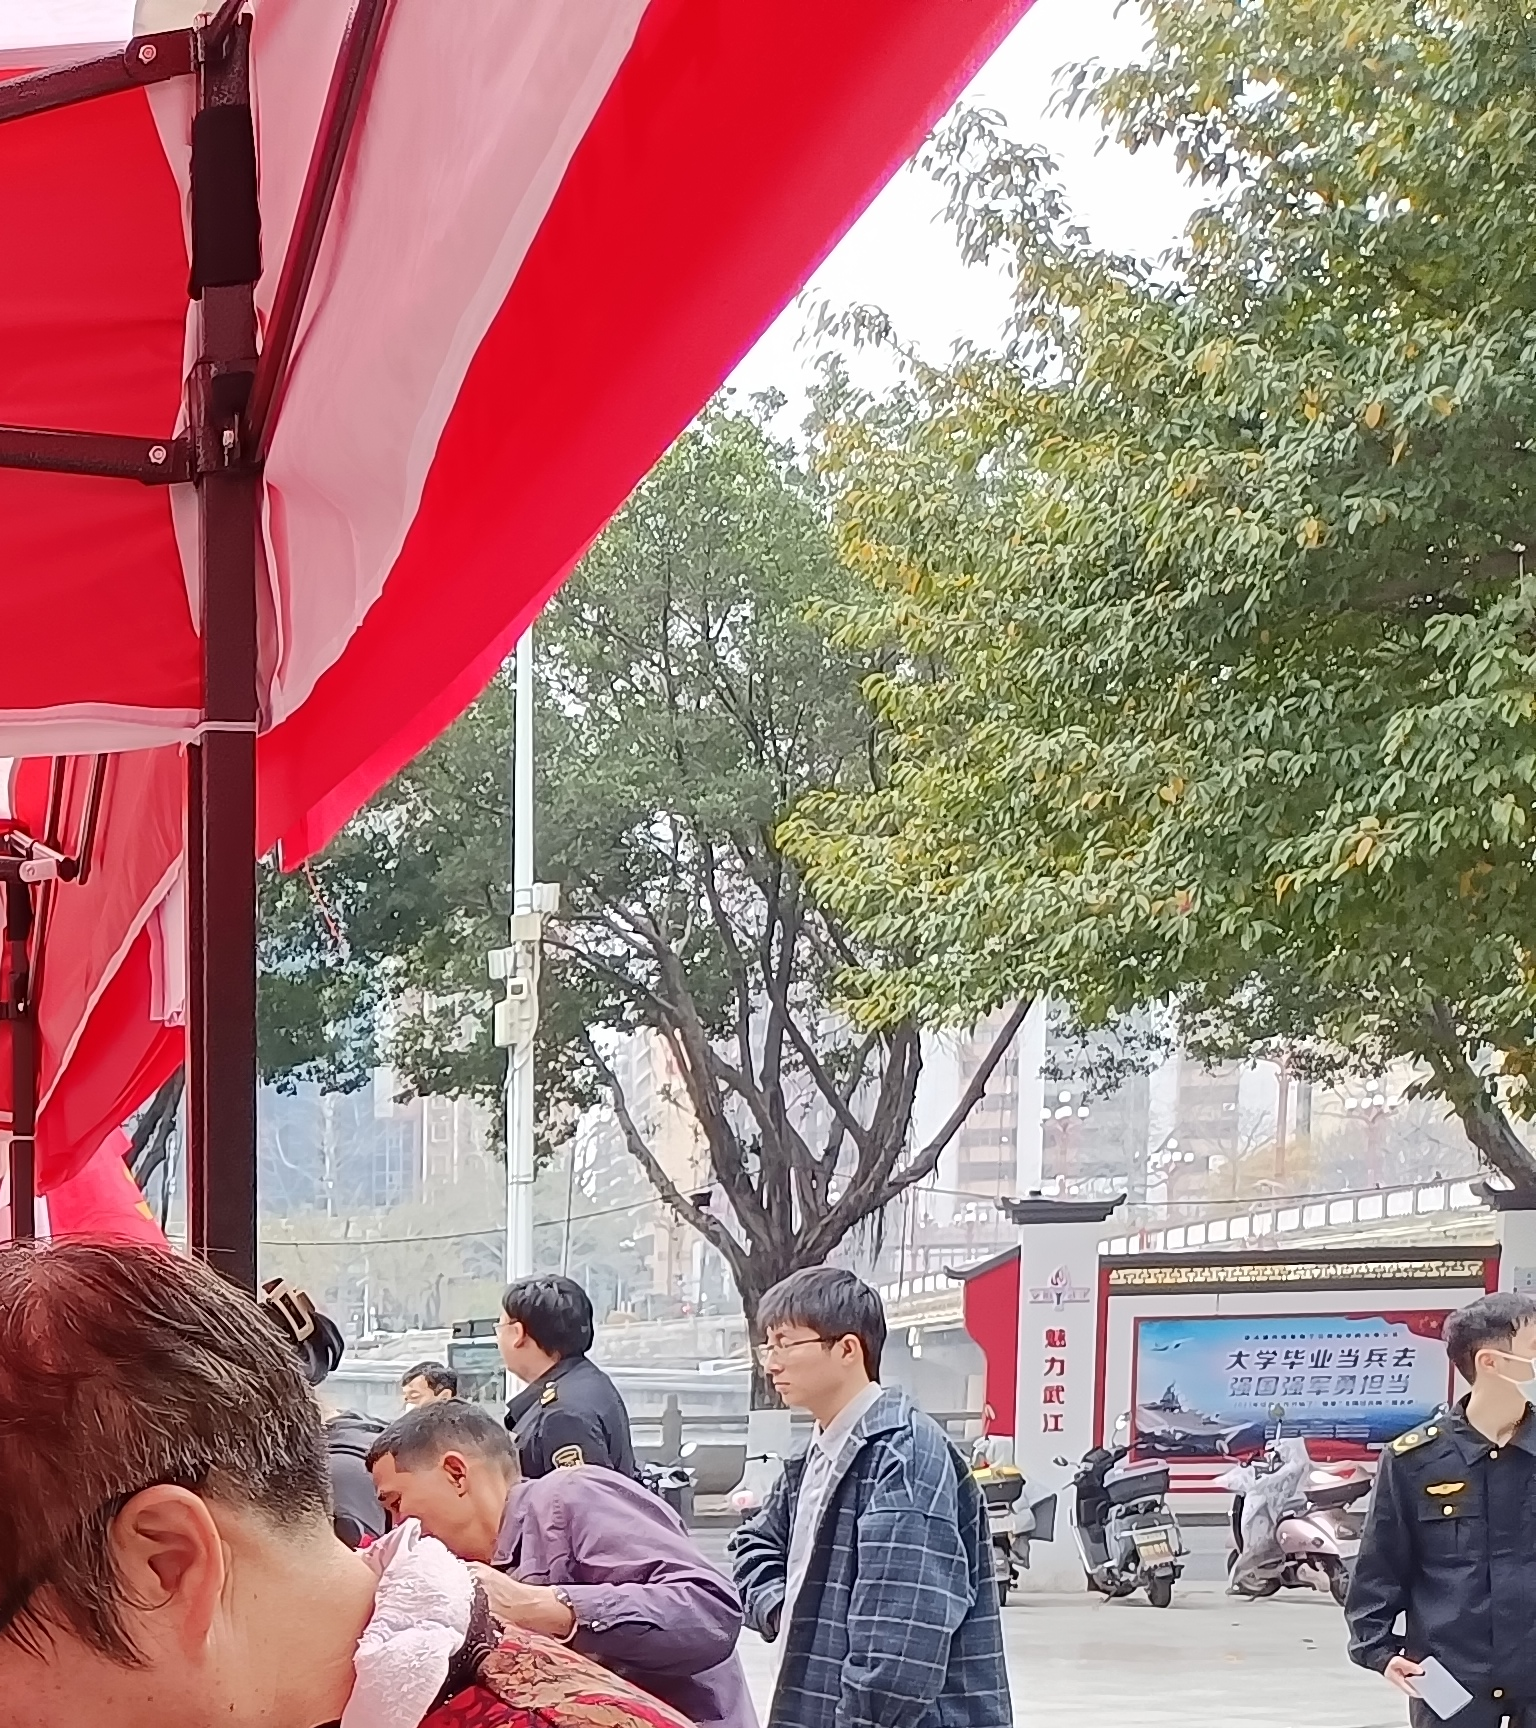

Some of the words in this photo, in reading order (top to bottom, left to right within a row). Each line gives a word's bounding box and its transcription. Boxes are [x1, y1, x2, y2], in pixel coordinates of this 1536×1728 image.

[1225, 1346, 1417, 1371] 大学毕业当兵去
[1042, 1328, 1068, 1434] 魅力武江
[1228, 1373, 1411, 1398] 强国强军勇担当
